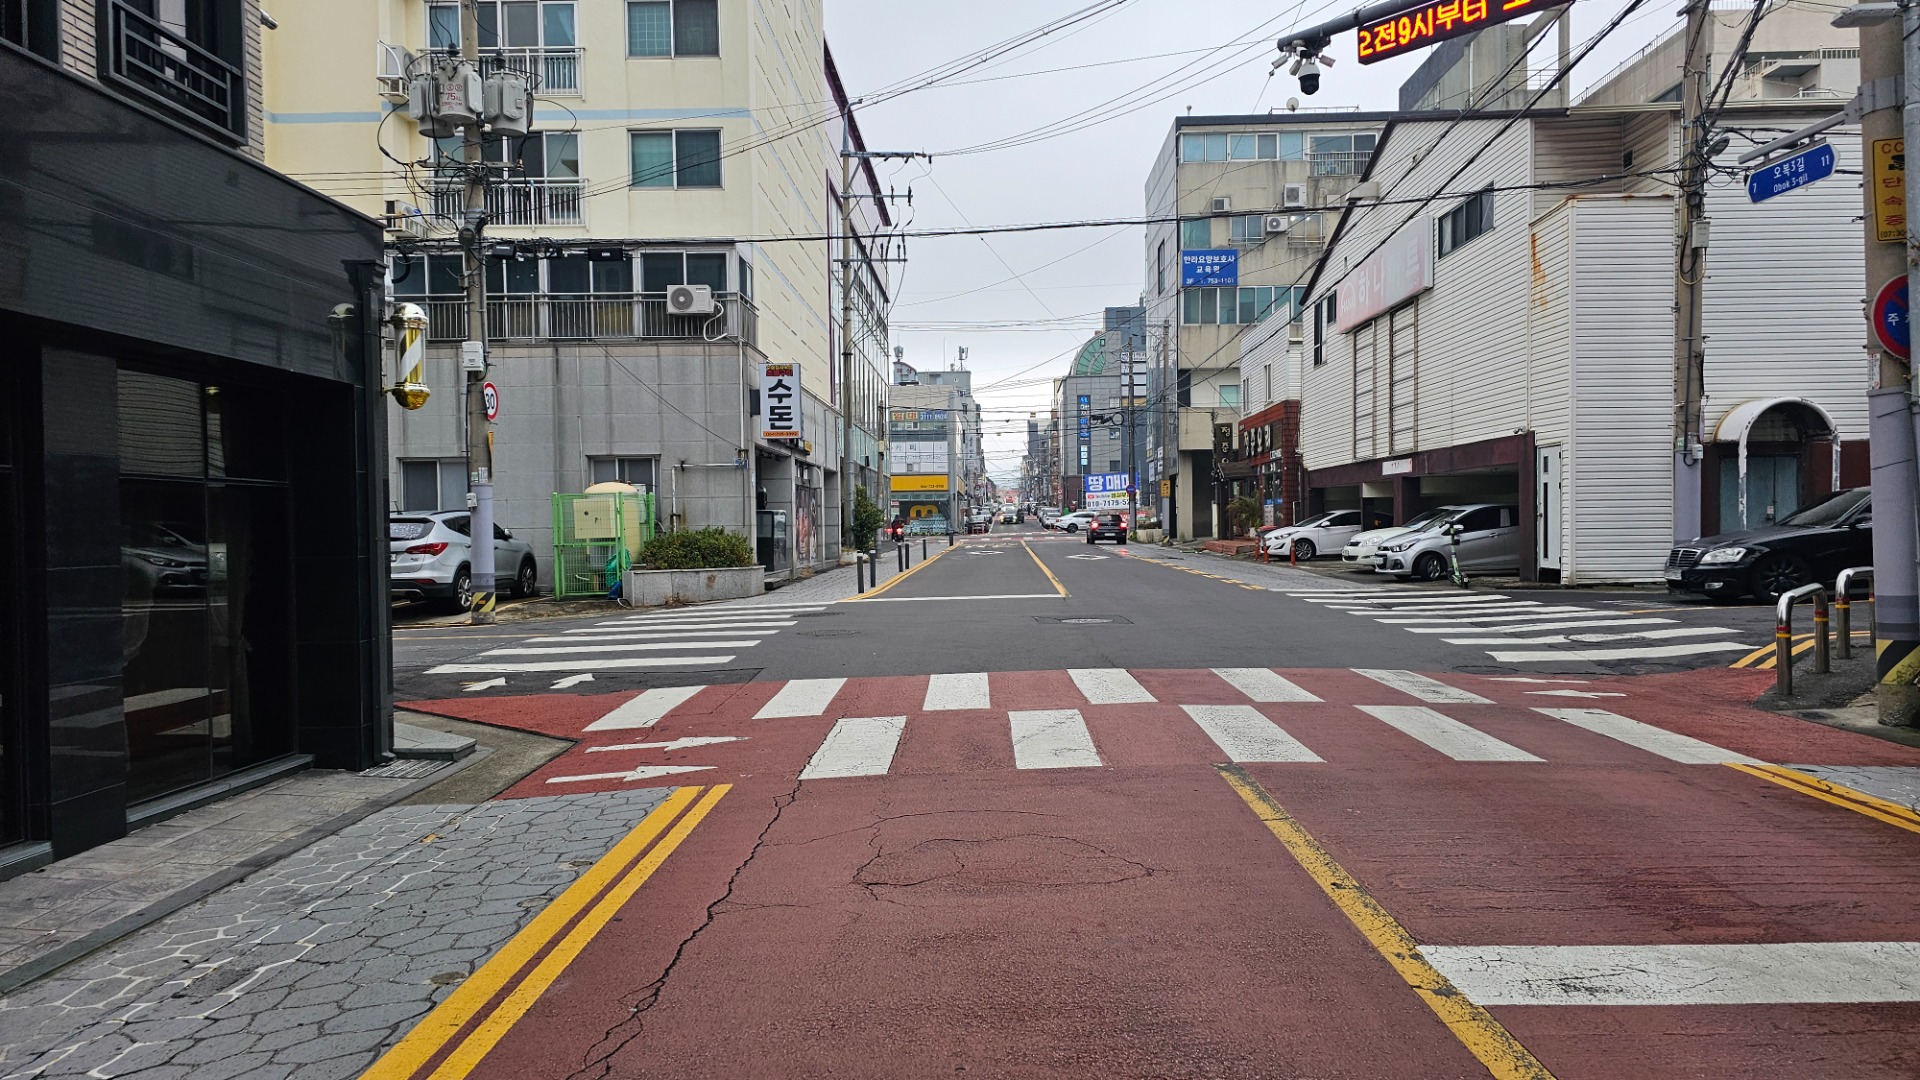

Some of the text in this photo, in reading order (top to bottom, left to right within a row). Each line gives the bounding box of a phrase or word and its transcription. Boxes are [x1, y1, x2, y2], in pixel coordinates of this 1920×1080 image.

[1774, 157, 1804, 180] 오복3길
[1820, 154, 1830, 168] 11
[1773, 173, 1808, 194] Obok 3-gil
[485, 393, 496, 410] 30
[768, 378, 794, 430] 수돈
